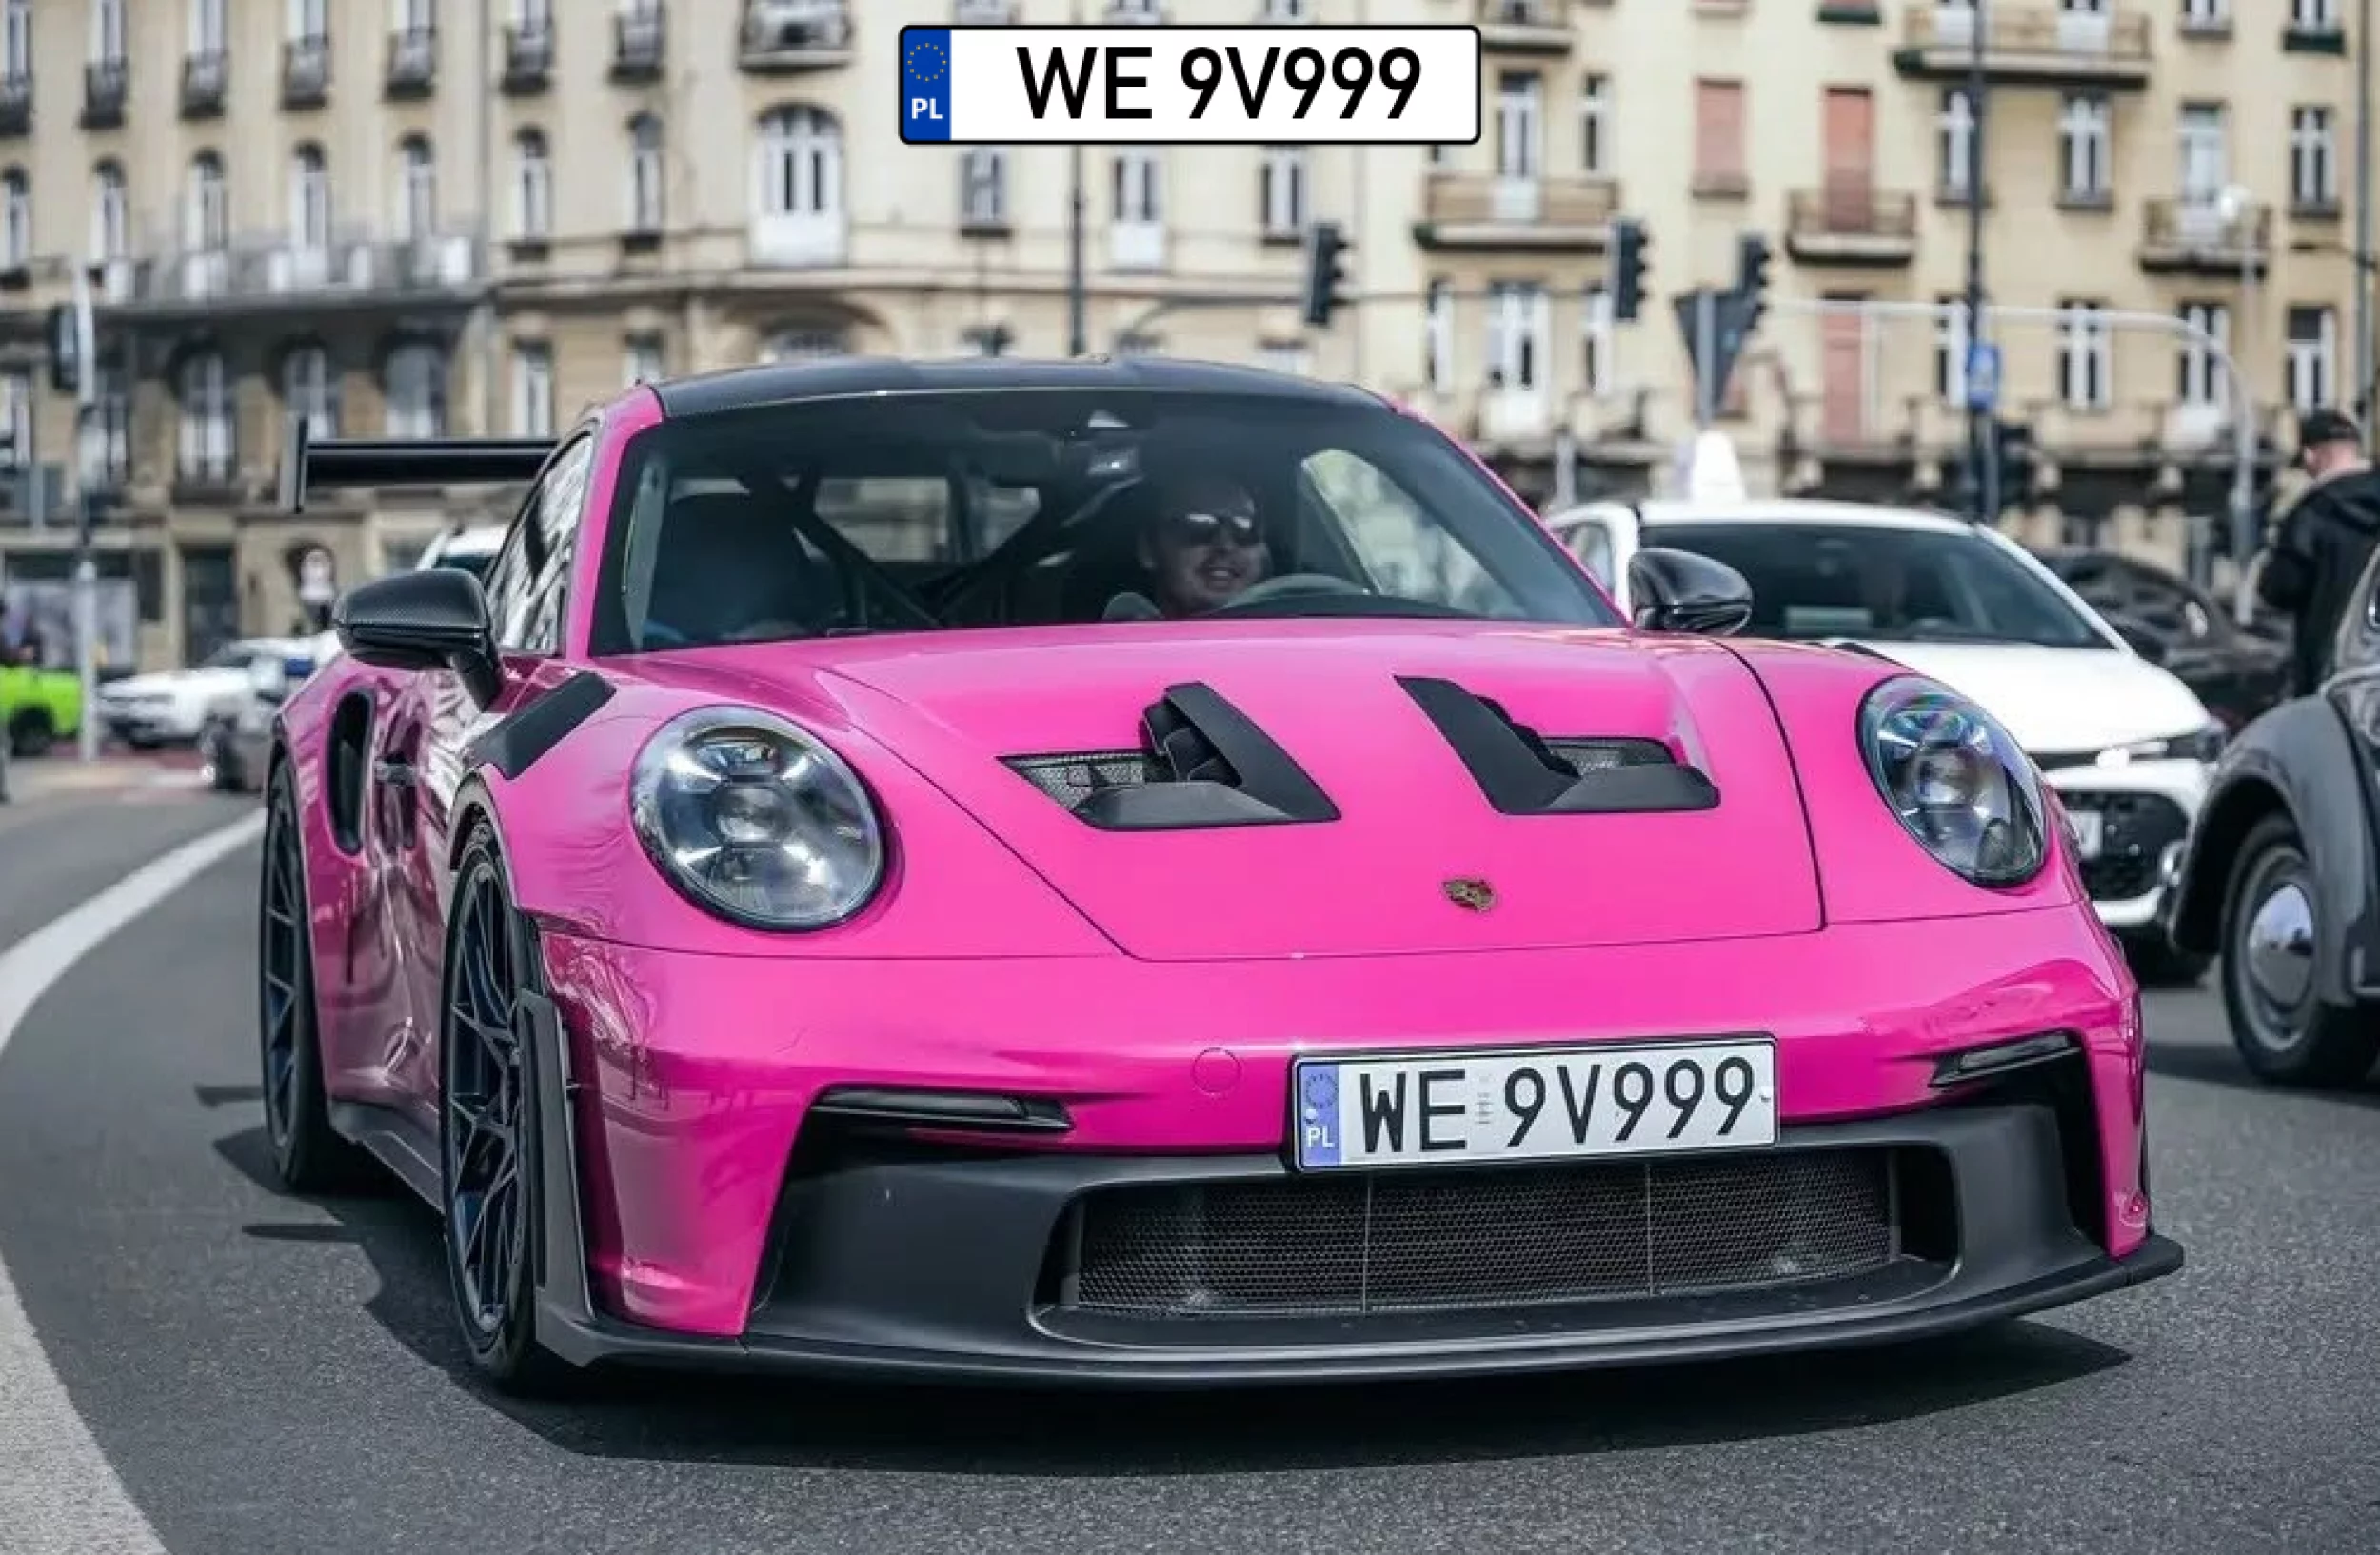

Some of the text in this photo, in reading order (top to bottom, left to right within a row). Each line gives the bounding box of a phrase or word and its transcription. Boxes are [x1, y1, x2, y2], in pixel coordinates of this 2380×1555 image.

[1359, 1068, 1466, 1153] WE
[1504, 1056, 1755, 1148] 9V999
[1306, 1127, 1335, 1149] PL
